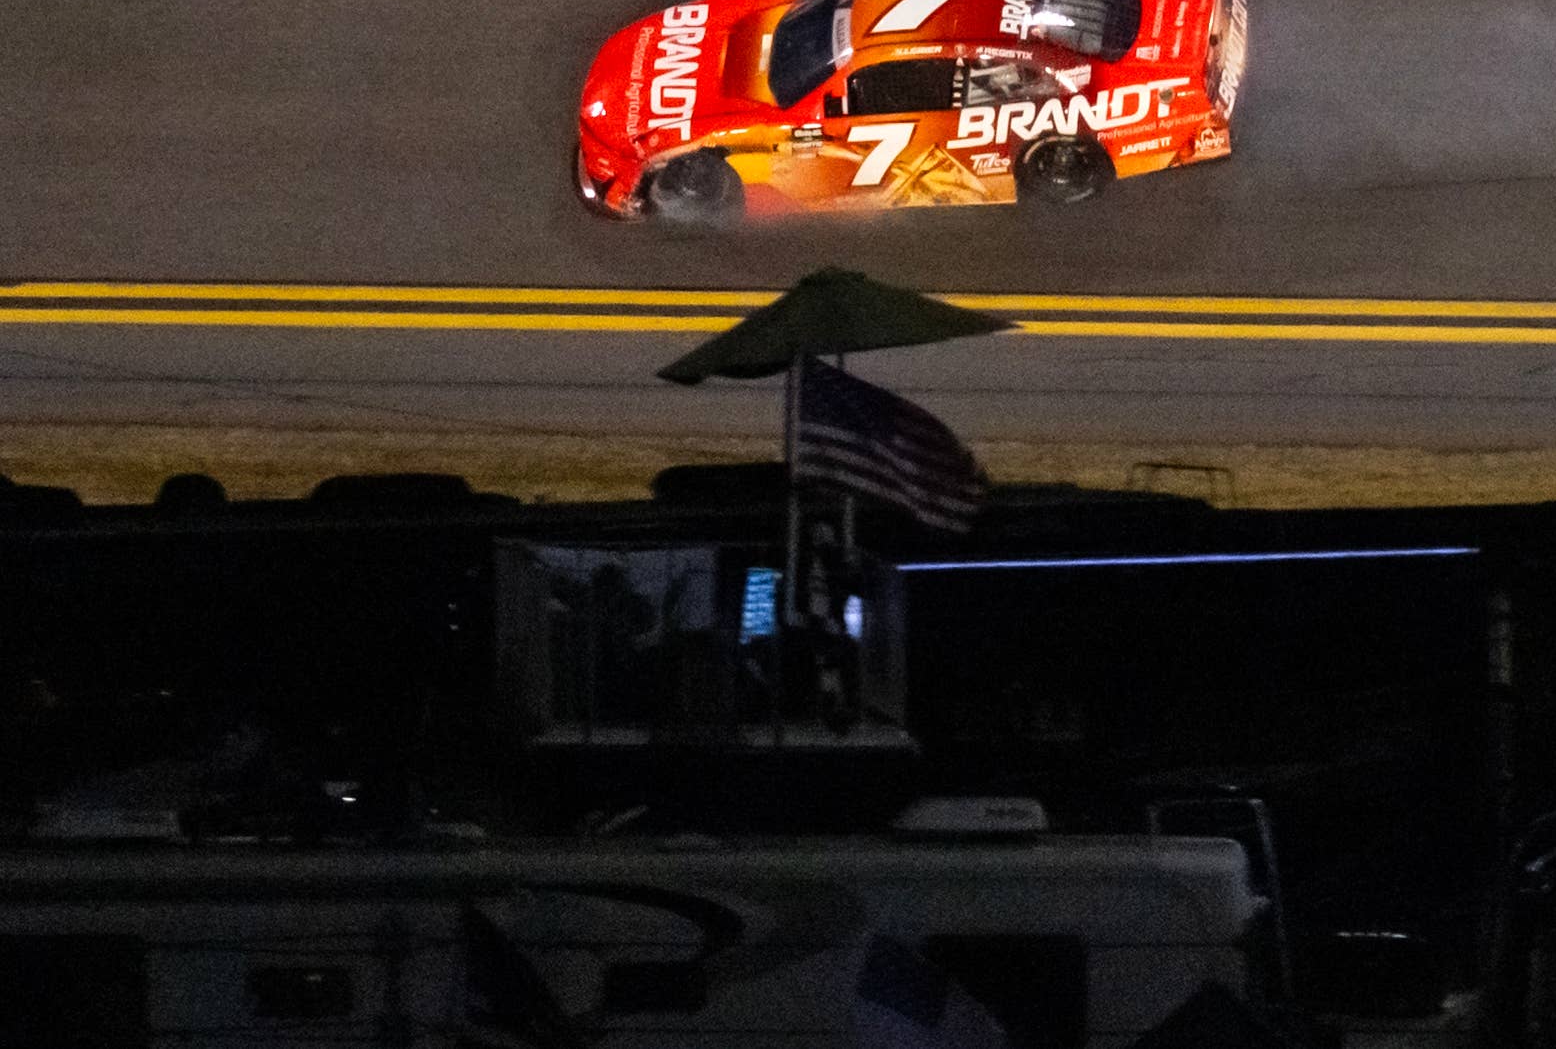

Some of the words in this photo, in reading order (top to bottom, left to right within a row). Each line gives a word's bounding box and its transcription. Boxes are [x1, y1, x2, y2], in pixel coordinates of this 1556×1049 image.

[648, 3, 709, 141] BRANDT
[946, 77, 1190, 150] BRANDT
[1097, 118, 1157, 141] Professional
[847, 122, 916, 186] 7
